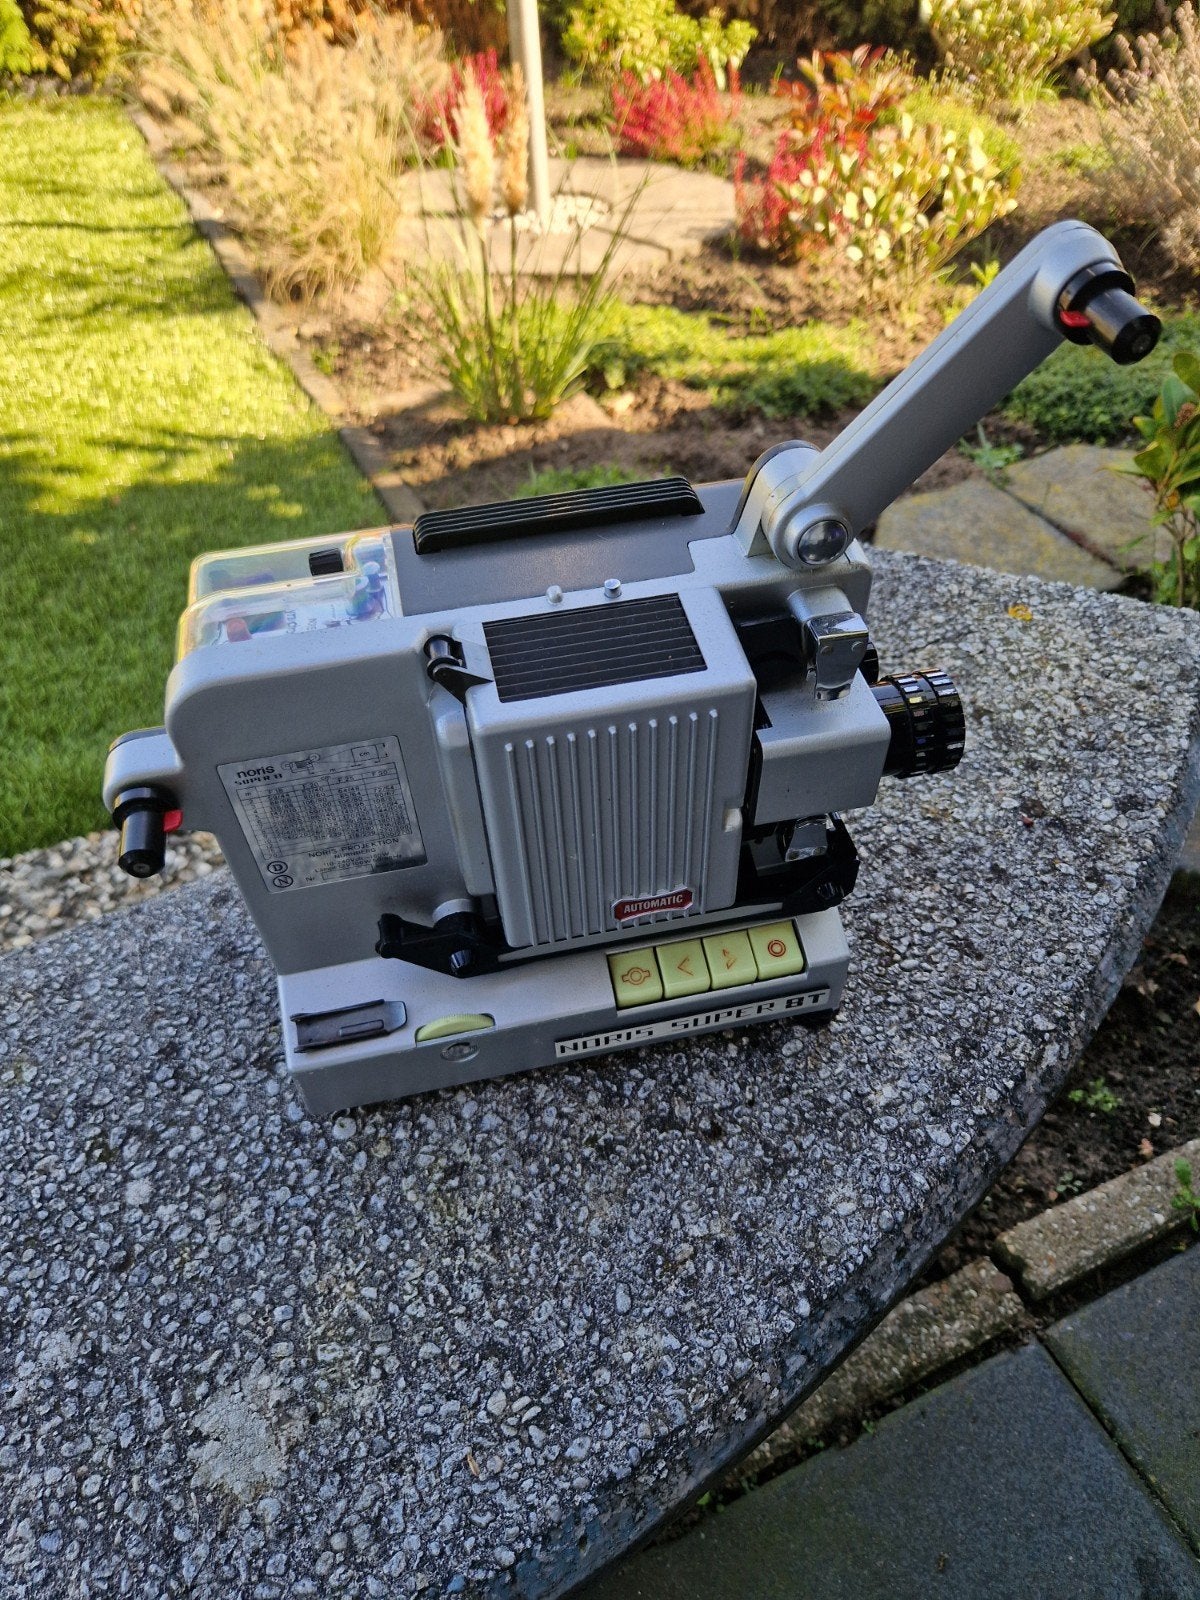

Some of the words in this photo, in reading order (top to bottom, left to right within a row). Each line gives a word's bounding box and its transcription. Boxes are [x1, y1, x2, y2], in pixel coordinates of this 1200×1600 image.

[236, 765, 275, 779] noris
[234, 774, 270, 786] SUPER
[307, 848, 338, 858] NORIS
[623, 894, 683, 914] AUTOMATIC
[560, 1028, 653, 1054] NORIS
[671, 1001, 775, 1029] SUPER
[785, 992, 826, 1008] 8T
